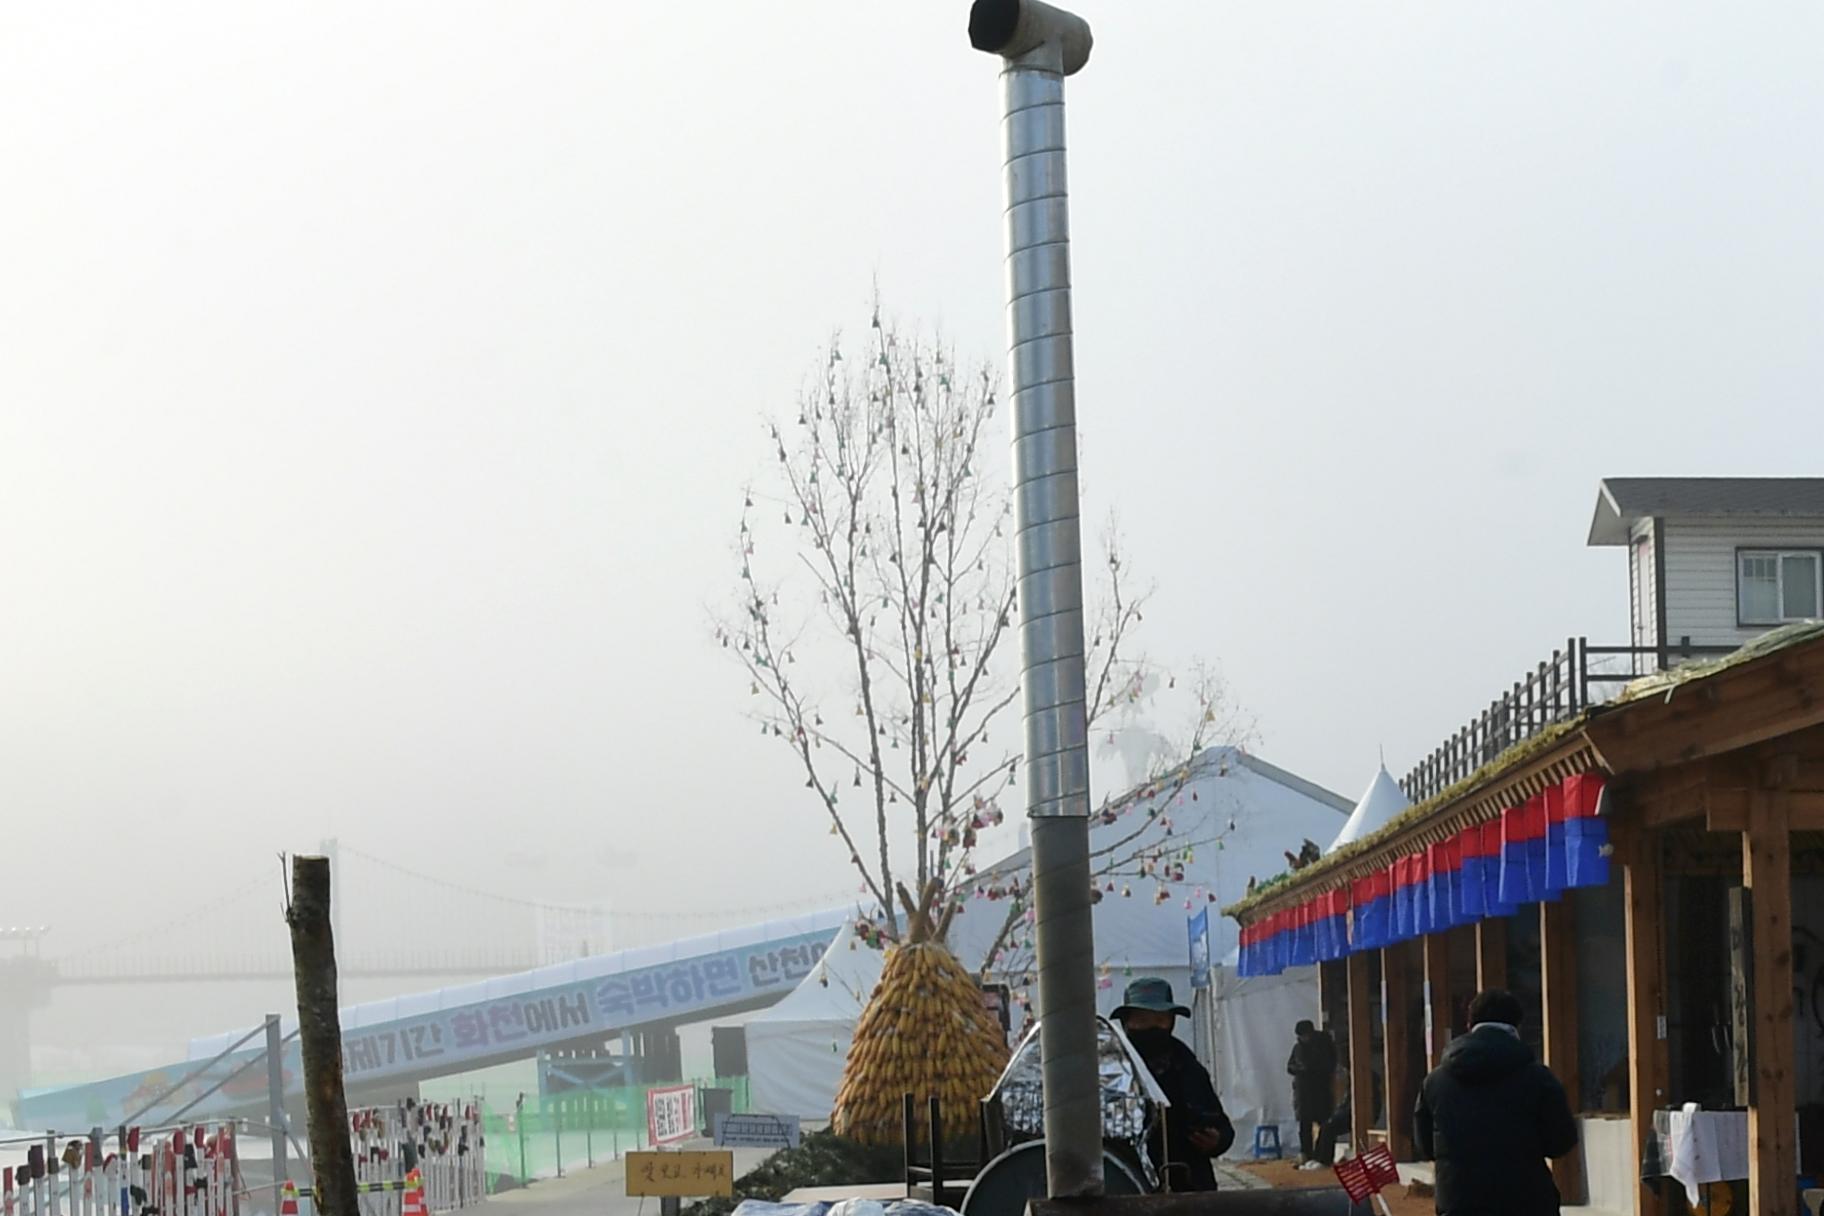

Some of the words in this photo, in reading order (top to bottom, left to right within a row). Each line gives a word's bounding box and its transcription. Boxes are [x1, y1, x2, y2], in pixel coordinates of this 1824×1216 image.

[343, 1021, 444, 1073] 제기간
[450, 991, 590, 1048] 화천에서
[598, 955, 742, 1015] 숙박하면
